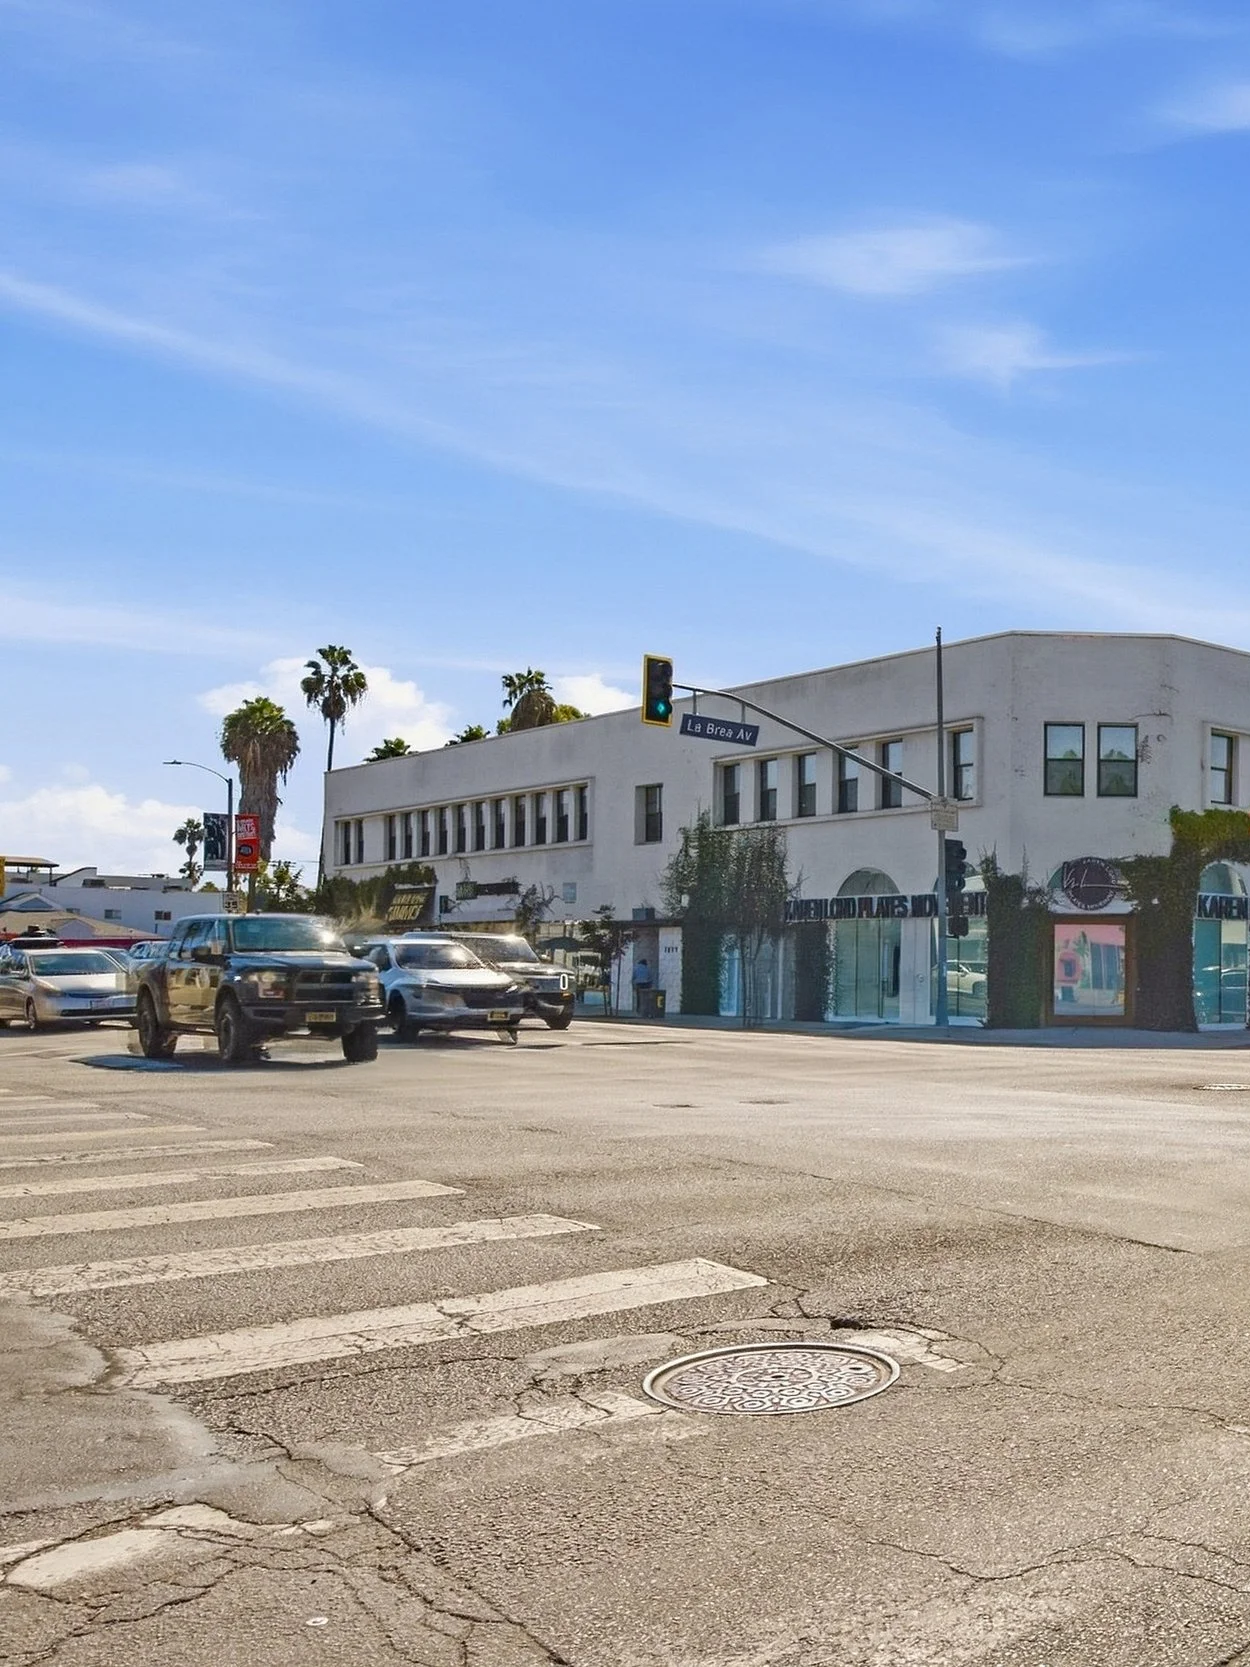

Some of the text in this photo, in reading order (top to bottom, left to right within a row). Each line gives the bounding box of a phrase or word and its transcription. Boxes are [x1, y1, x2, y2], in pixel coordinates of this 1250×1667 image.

[687, 719, 753, 741] La Brea Av
[858, 896, 909, 919] PILATES
[910, 892, 987, 918] MOVEENT
[1197, 894, 1249, 920] KAREN
